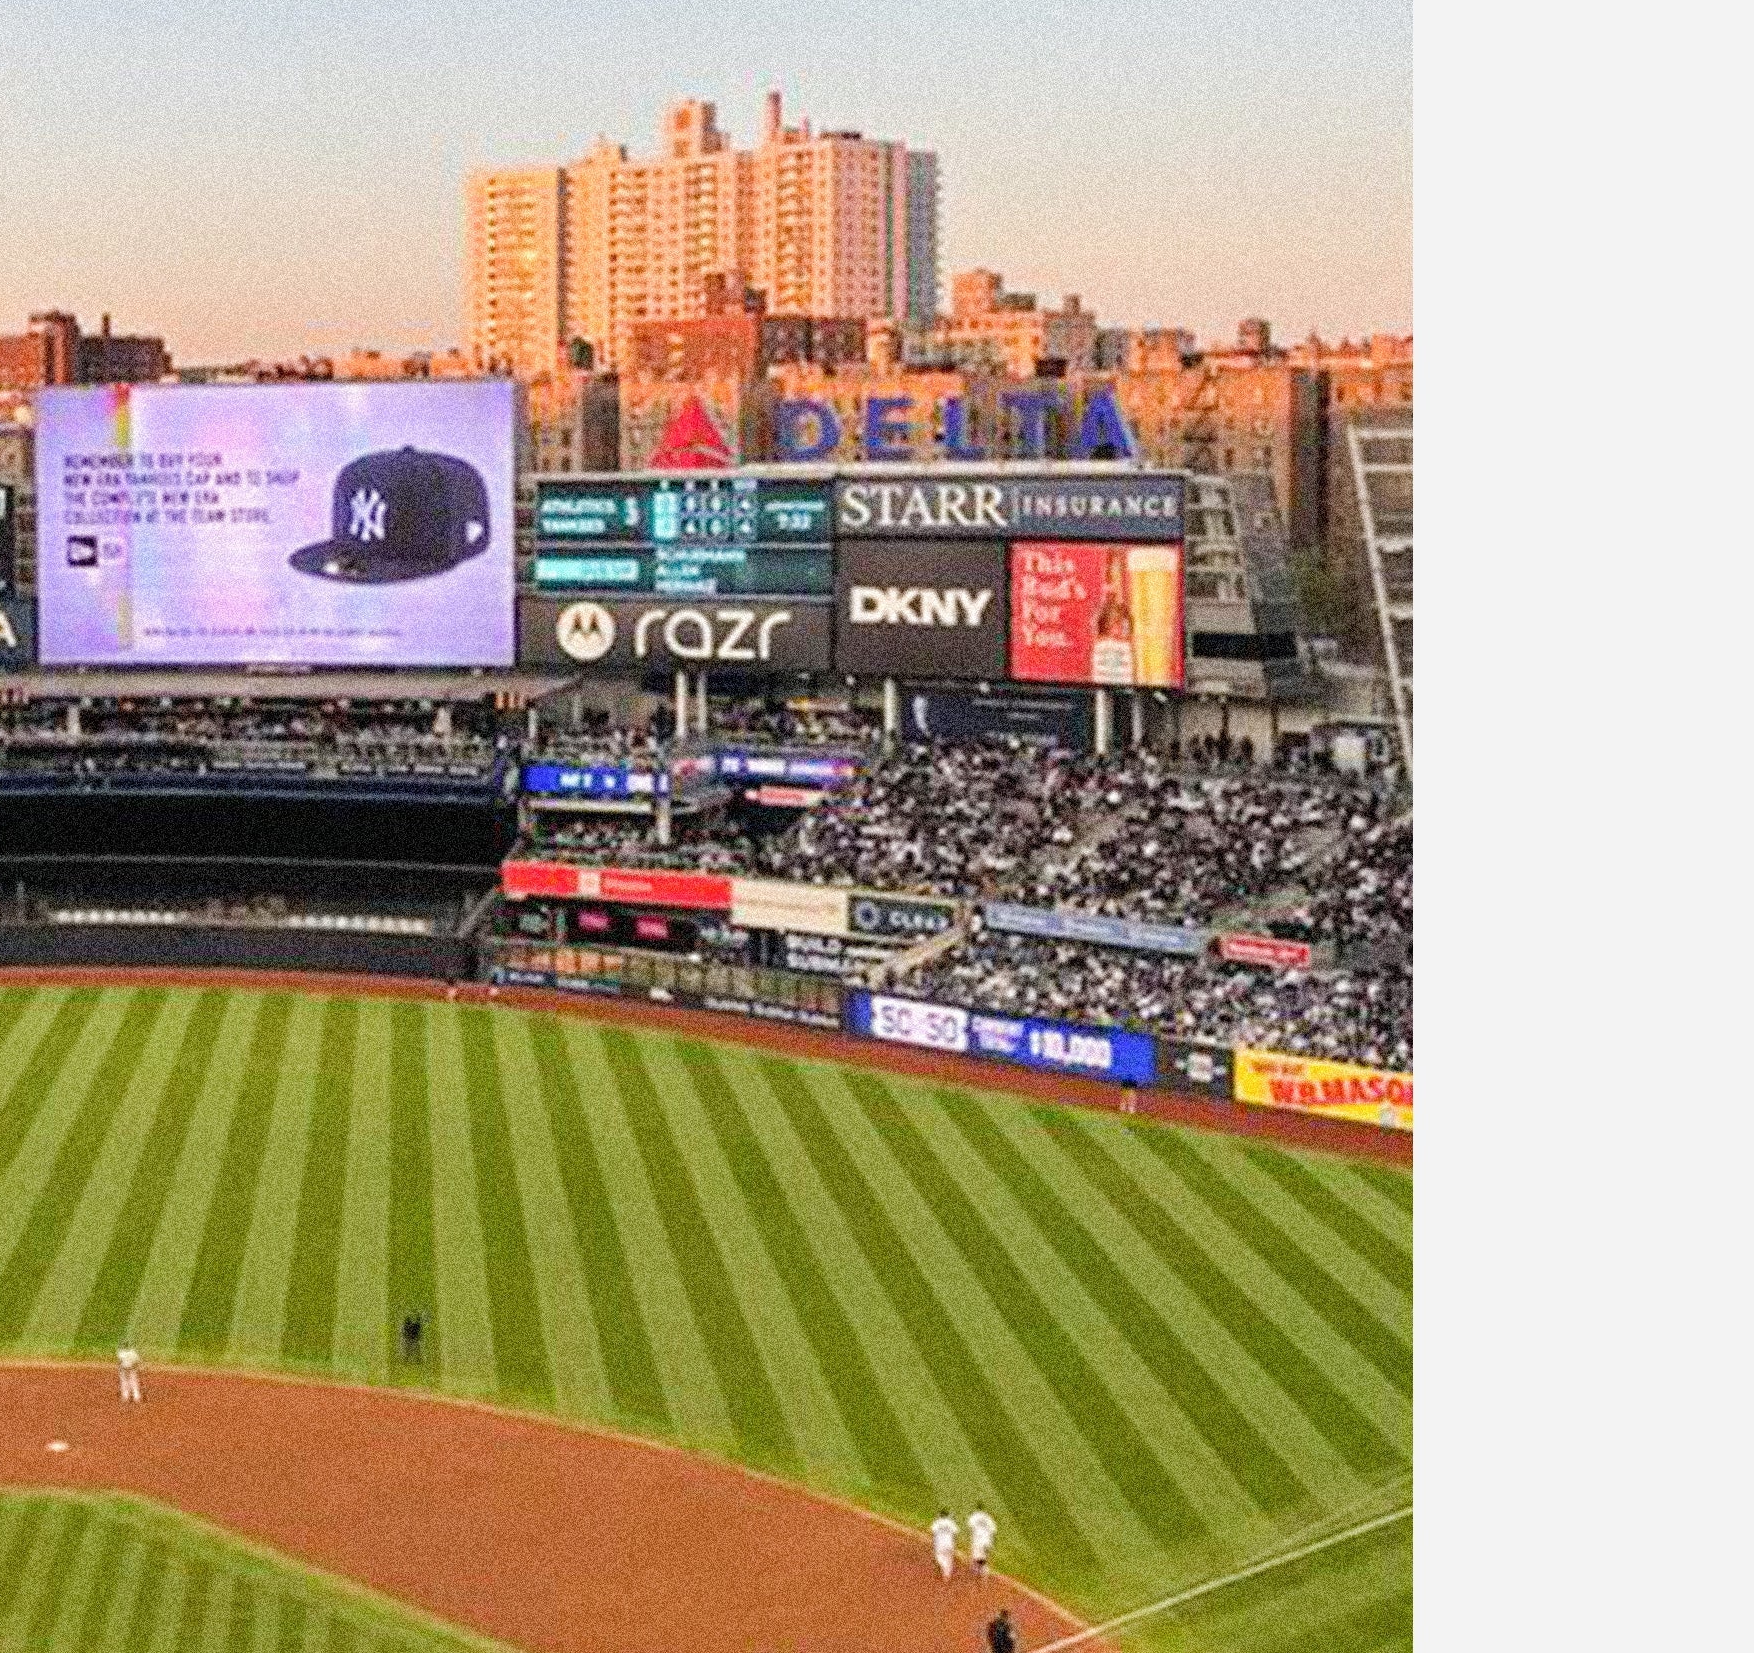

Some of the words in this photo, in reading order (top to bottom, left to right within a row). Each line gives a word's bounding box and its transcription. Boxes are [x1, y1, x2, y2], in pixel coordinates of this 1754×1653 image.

[776, 391, 1133, 460] DELTA
[841, 484, 1007, 526] STARR
[1023, 496, 1177, 516] INSURANCE
[1023, 552, 1075, 573] This
[850, 586, 992, 625] DKNY
[1023, 576, 1087, 598] Bud's
[1023, 602, 1061, 623] For
[635, 608, 792, 661] razr
